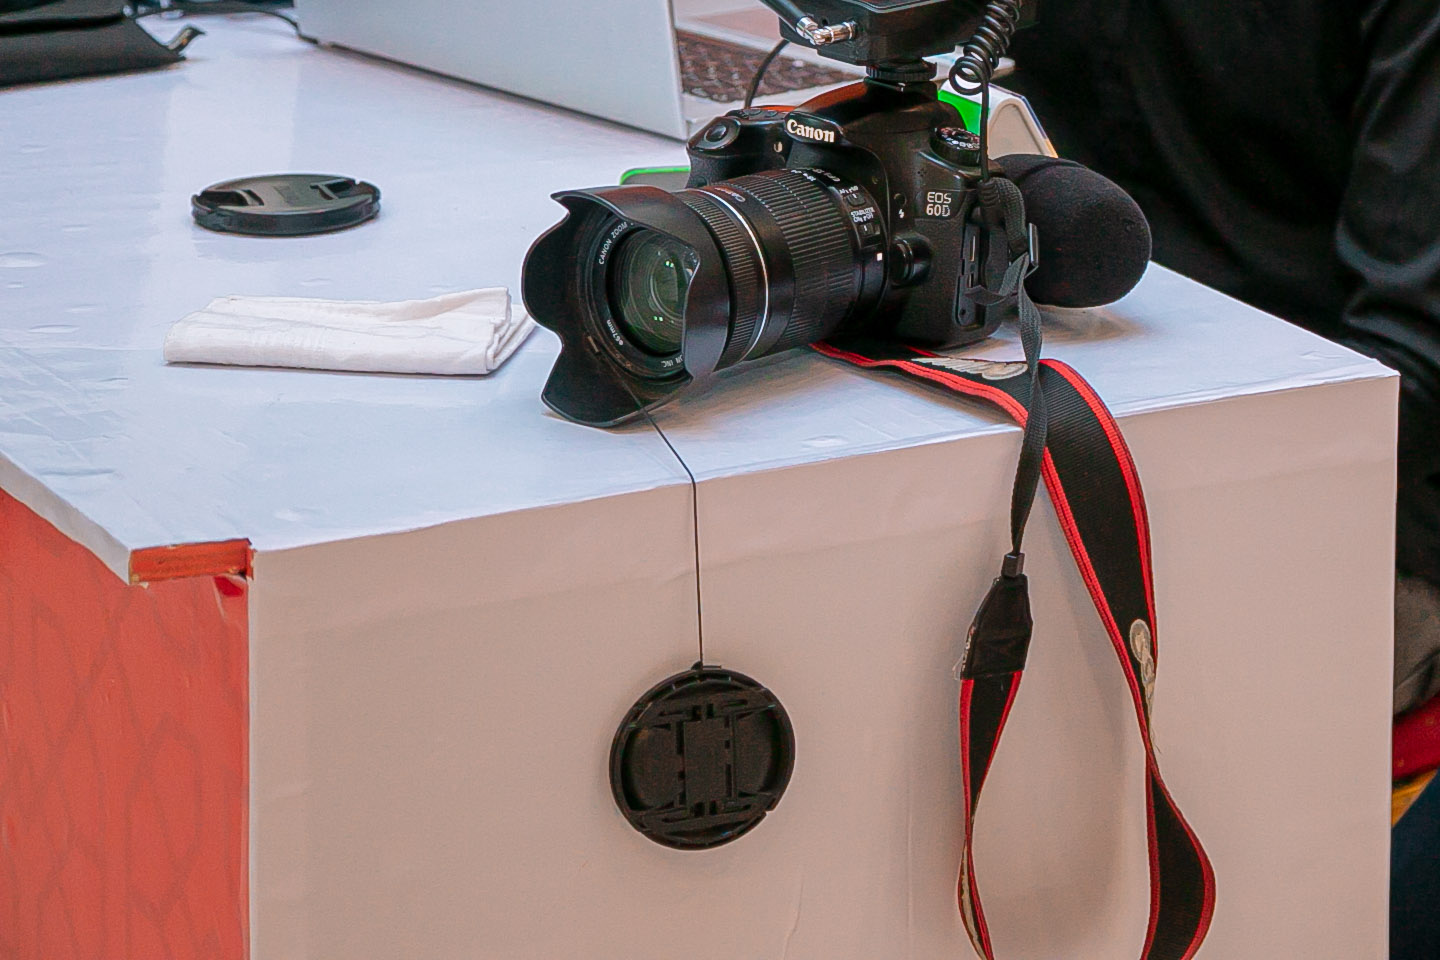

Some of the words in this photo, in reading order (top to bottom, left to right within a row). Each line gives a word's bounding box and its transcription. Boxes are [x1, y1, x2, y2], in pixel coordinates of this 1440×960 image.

[786, 119, 835, 143] Canon
[926, 191, 952, 204] EOS
[926, 204, 951, 217] 60D
[598, 238, 613, 265] CANON
[610, 221, 628, 239] ZOOM
